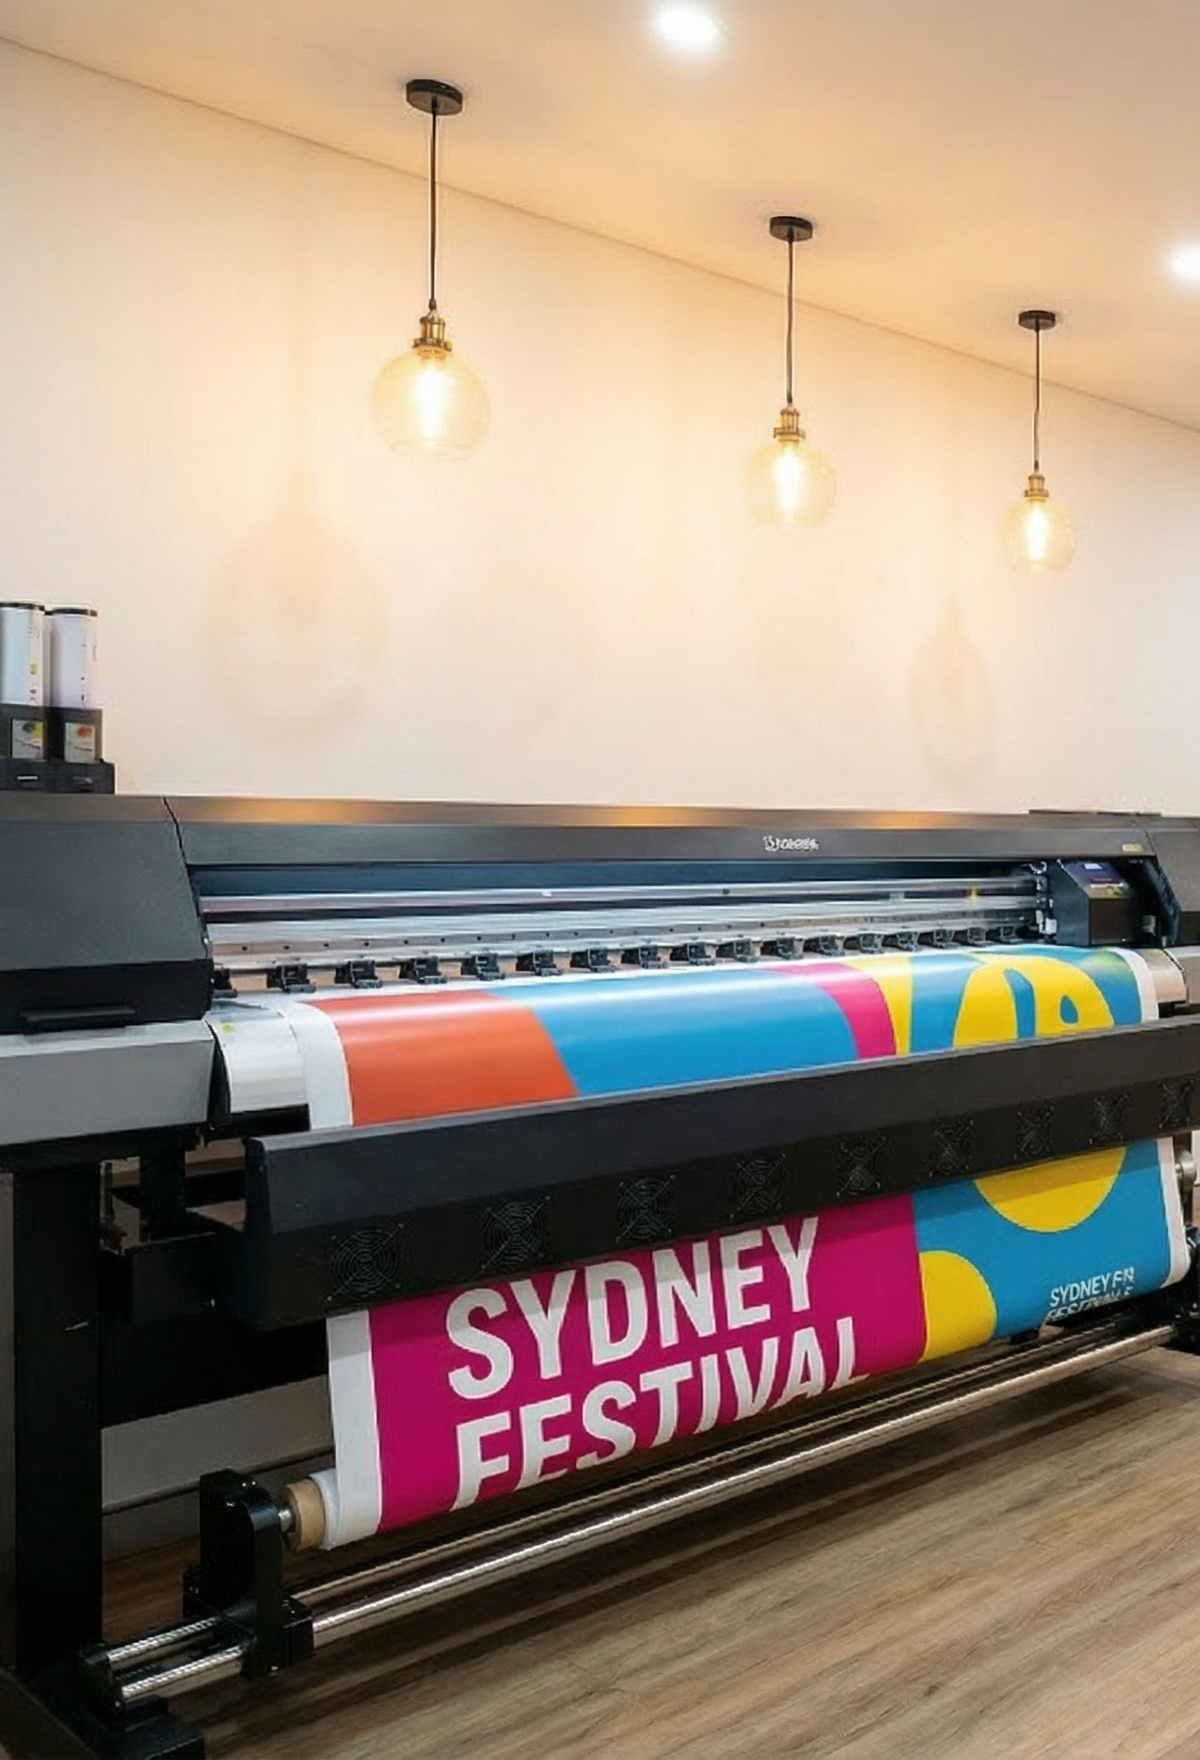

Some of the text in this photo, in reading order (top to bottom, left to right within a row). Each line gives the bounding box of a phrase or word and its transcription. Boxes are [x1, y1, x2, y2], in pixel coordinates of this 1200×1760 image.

[445, 1215, 819, 1401] SYDNEY
[1049, 1272, 1111, 1308] SYDNEY
[448, 1315, 870, 1513] FESTIVAL
